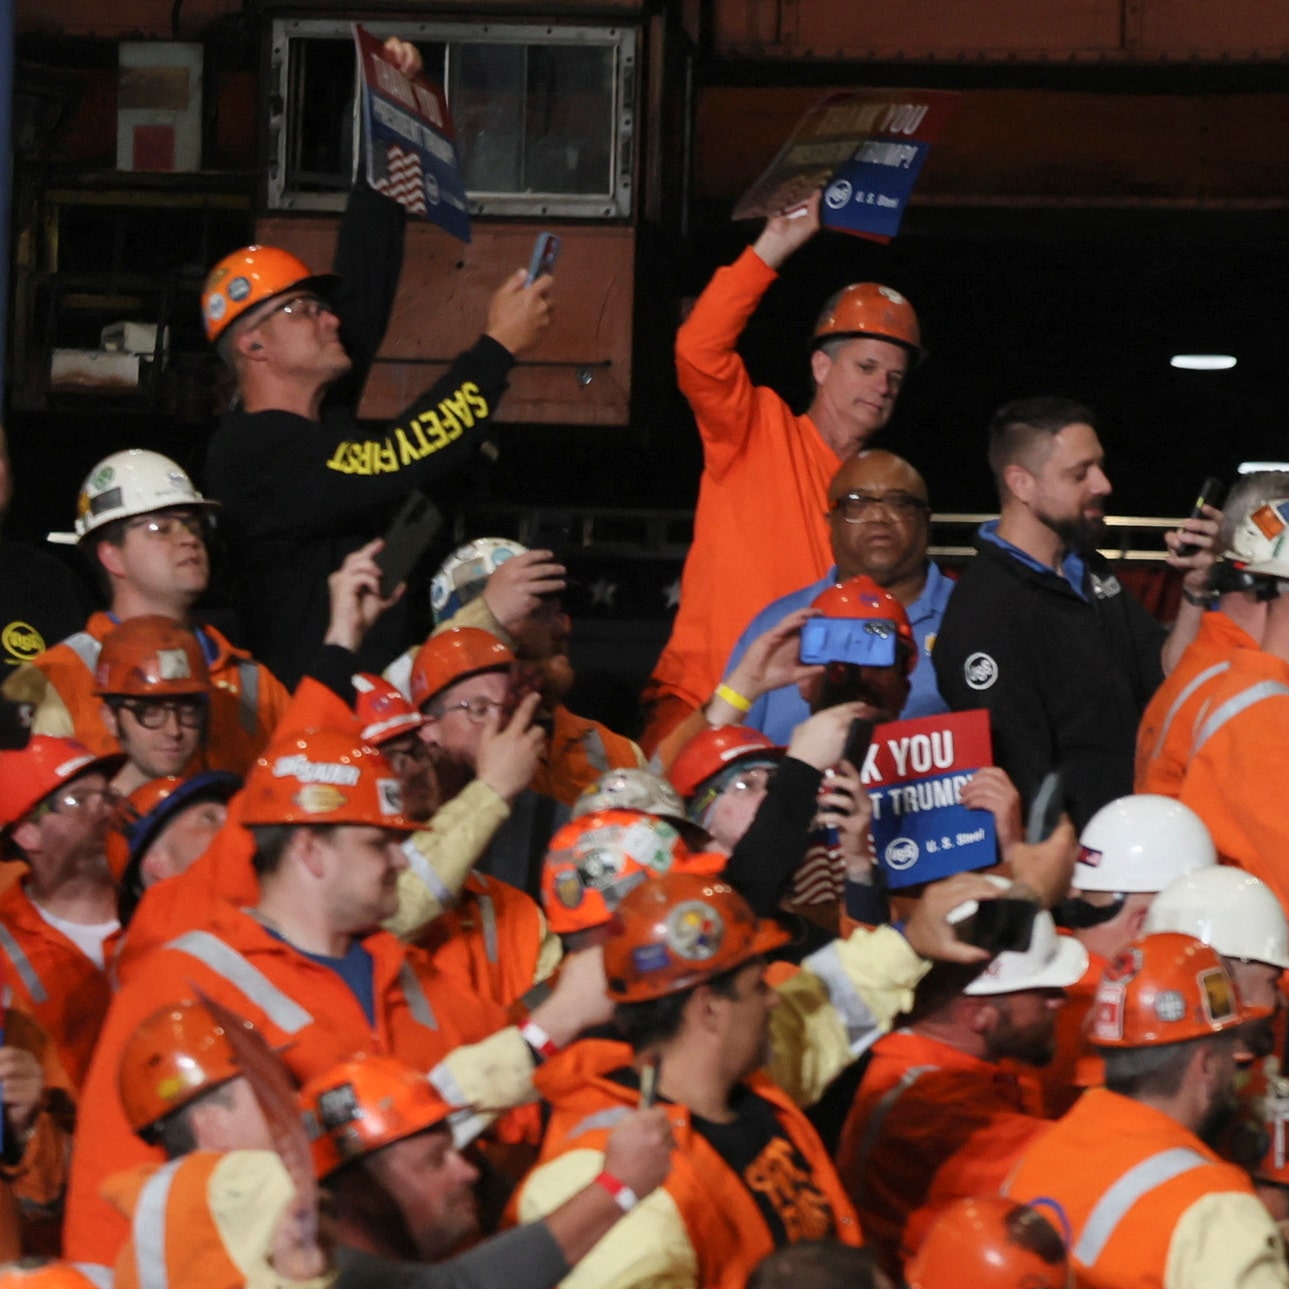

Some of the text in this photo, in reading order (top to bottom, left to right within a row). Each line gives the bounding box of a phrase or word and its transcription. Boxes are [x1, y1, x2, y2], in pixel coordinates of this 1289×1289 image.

[326, 381, 488, 475] SAFETY FIRST
[887, 730, 955, 776] YOU
[956, 828, 985, 847] Steel
